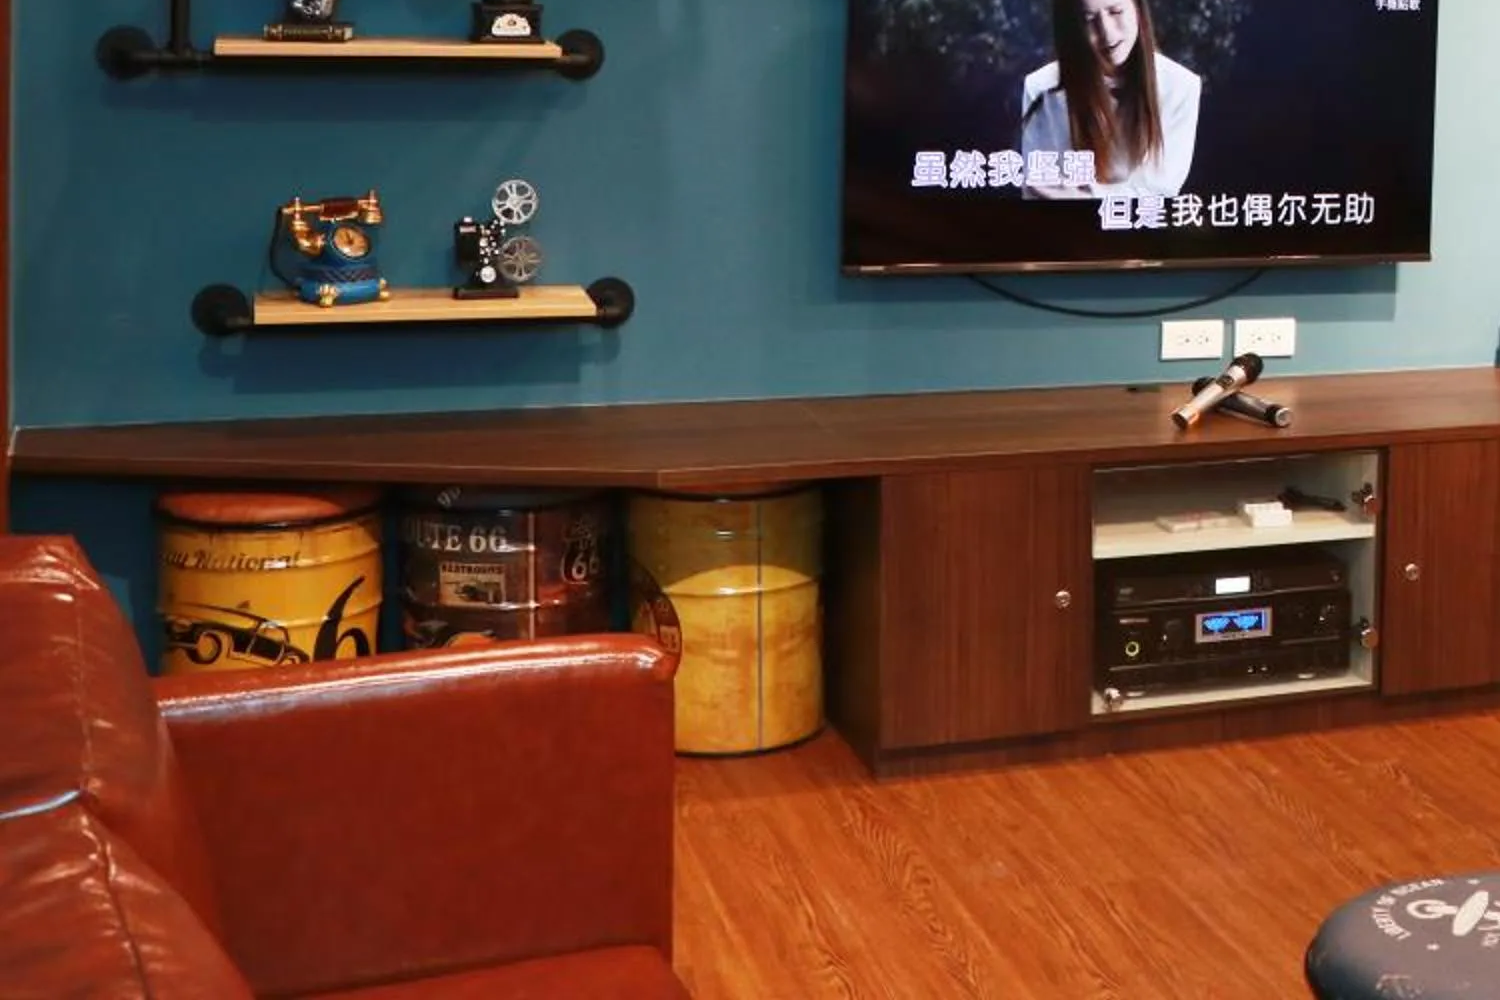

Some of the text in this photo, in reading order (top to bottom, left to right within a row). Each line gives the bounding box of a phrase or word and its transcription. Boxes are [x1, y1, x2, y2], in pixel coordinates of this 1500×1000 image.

[912, 150, 1097, 188] 虽然我坚强
[1098, 193, 1376, 229] 但是我也偶尔无助
